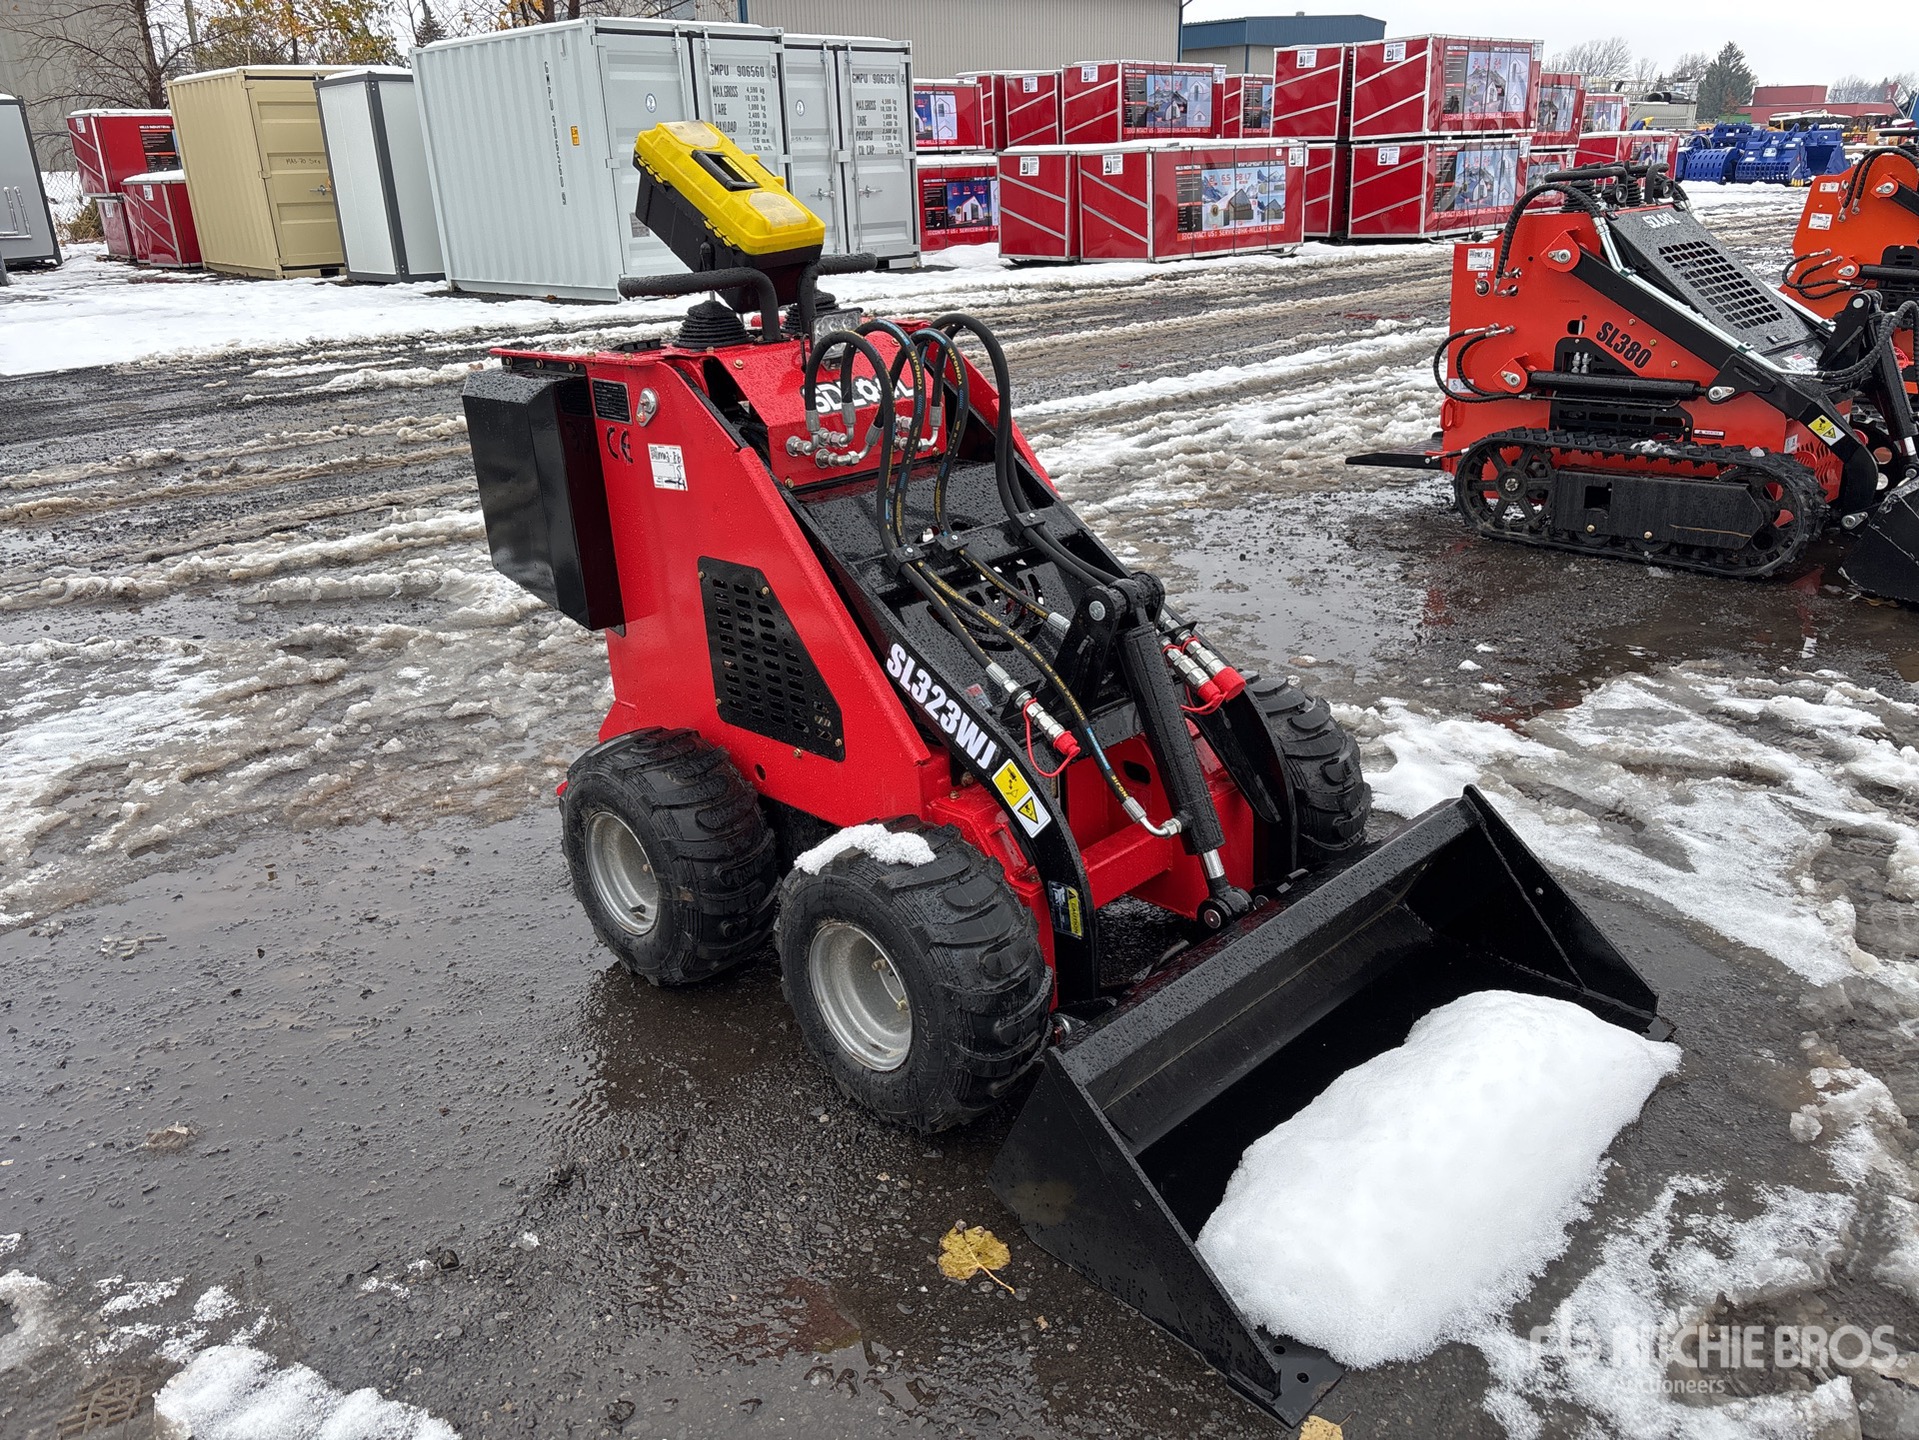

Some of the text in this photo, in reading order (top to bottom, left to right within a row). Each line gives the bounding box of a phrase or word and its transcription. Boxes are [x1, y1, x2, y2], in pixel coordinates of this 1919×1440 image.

[736, 66, 764, 78] 906560
[771, 66, 777, 78] 9
[872, 74, 895, 84] 906236
[714, 104, 727, 116] TARE
[1596, 322, 1652, 368] SL380
[886, 643, 997, 770] SL323WJ
